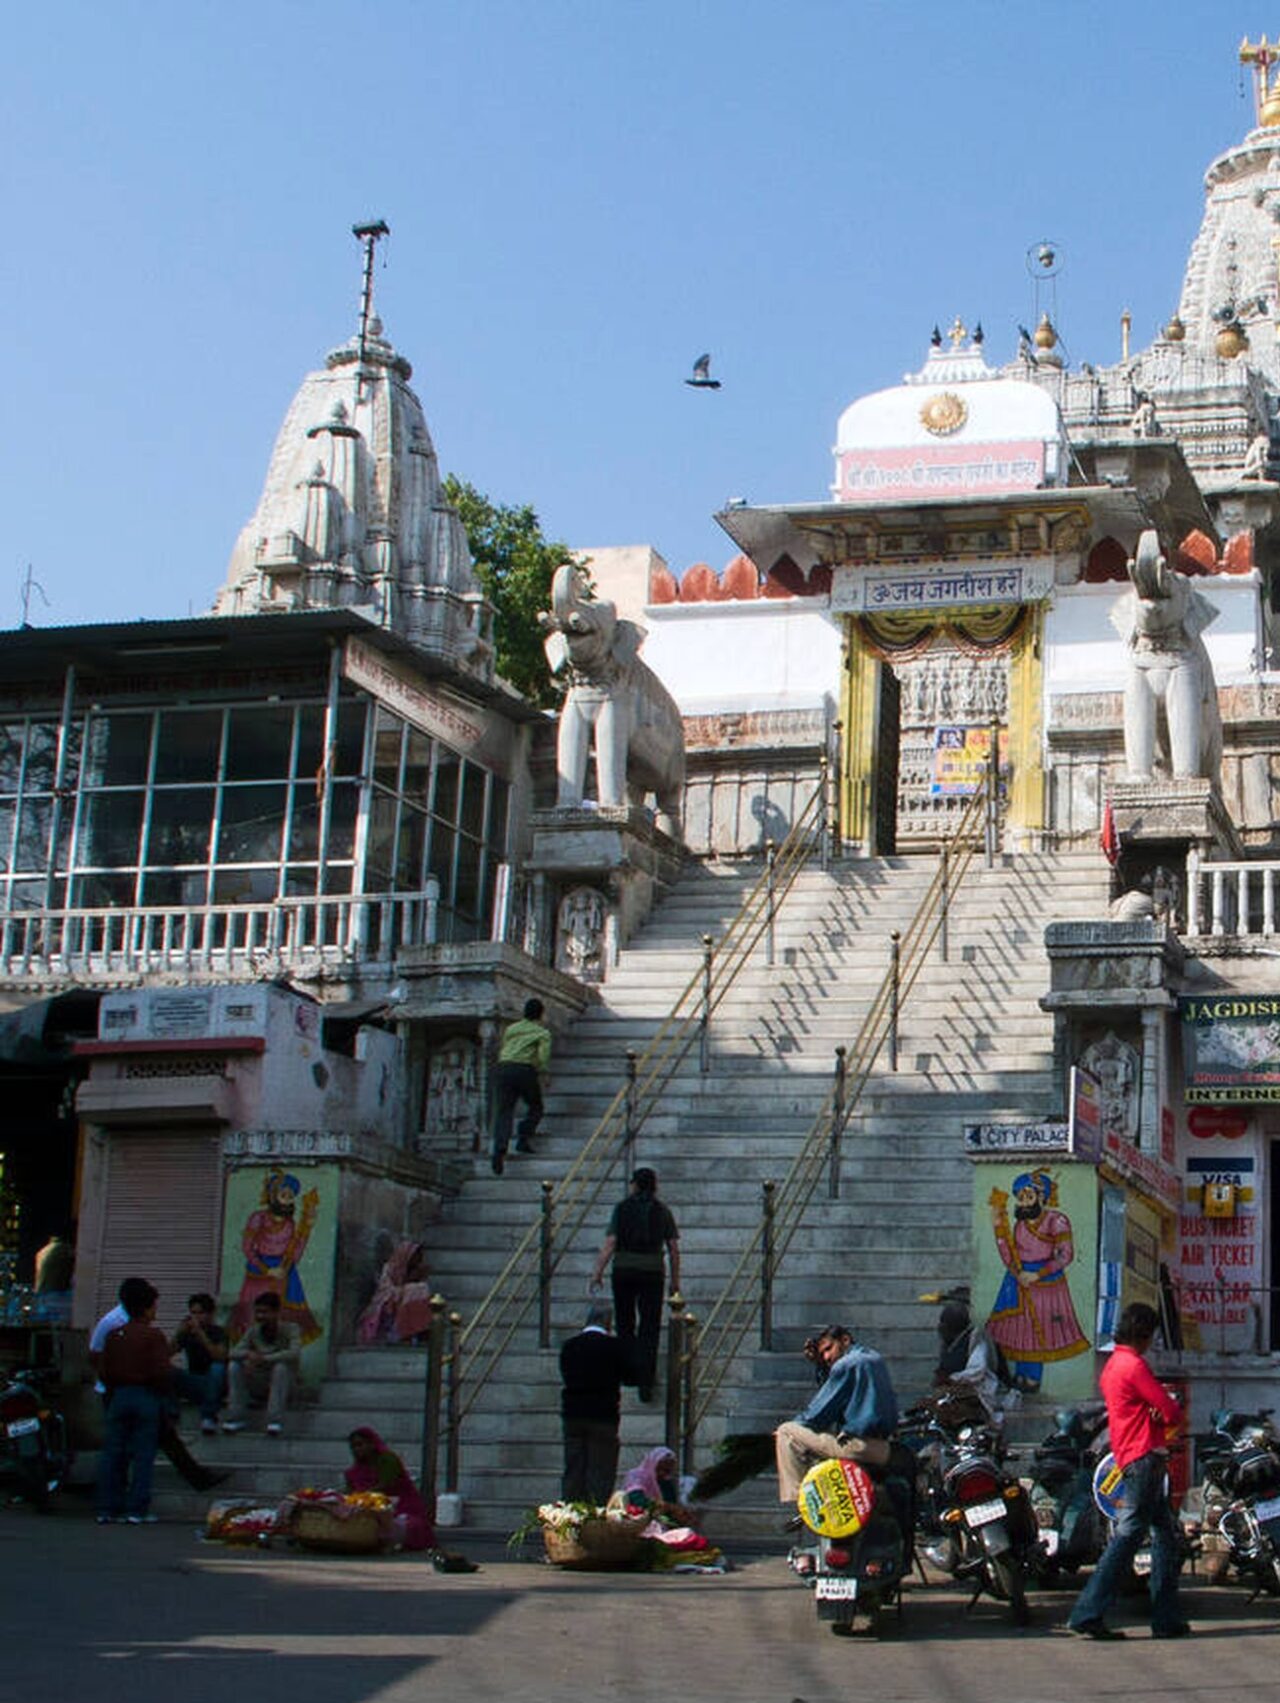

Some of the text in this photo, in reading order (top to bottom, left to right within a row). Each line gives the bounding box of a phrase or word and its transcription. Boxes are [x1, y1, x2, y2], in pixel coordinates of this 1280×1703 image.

[929, 571, 993, 599] जगदीश
[987, 1128, 1019, 1144] CITY
[1201, 1174, 1242, 1186] VISA
[1180, 1216, 1256, 1237] BUS TICKET
[1181, 1244, 1255, 1266] AIR TICKET
[829, 1467, 854, 1525] OKAYA
